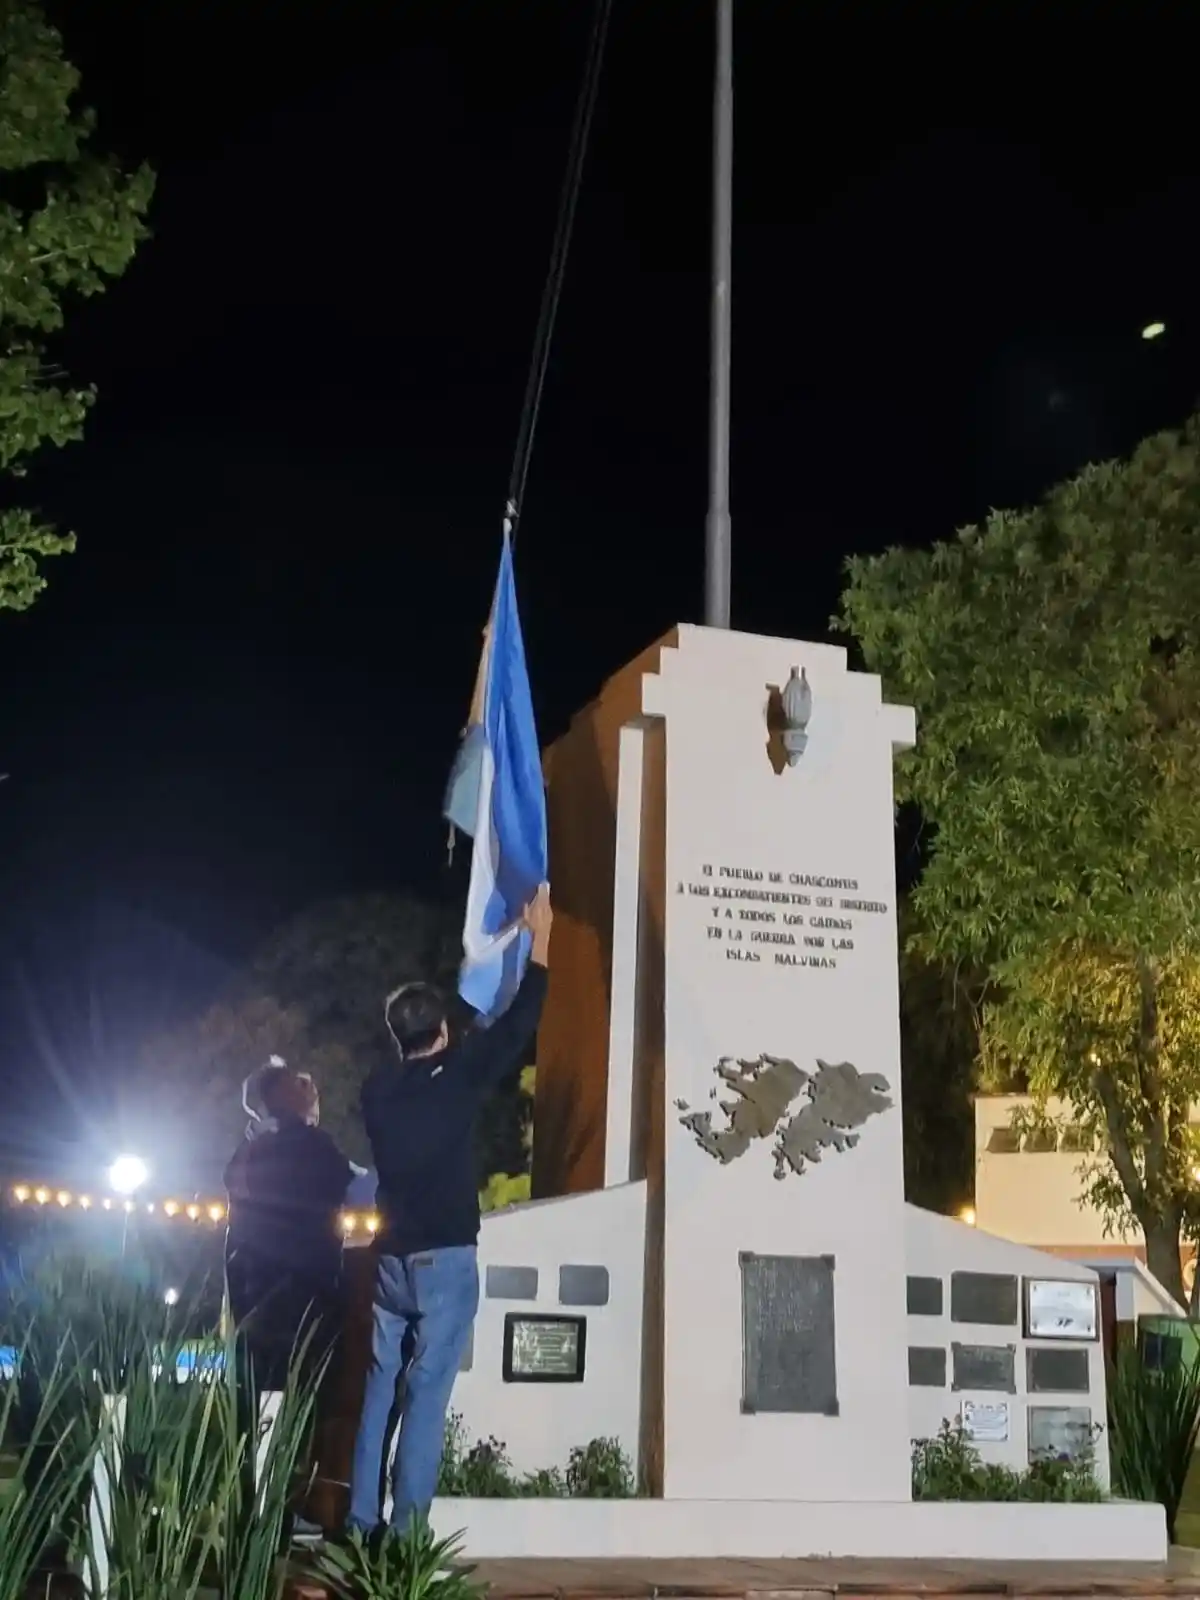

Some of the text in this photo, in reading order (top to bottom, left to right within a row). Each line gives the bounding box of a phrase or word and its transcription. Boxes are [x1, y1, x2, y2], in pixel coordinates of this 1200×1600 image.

[719, 867, 763, 881] PUEBLO
[769, 872, 783, 883] DE
[676, 881, 684, 894] A
[689, 883, 710, 897] LOS
[712, 907, 719, 918] Y
[725, 909, 733, 919] A
[739, 910, 776, 923] TODOS
[783, 914, 803, 925] LOS
[707, 926, 722, 939] EN
[729, 929, 742, 941] LA
[832, 939, 854, 950] LAS
[726, 949, 836, 968] ISLAS MALVINAS
